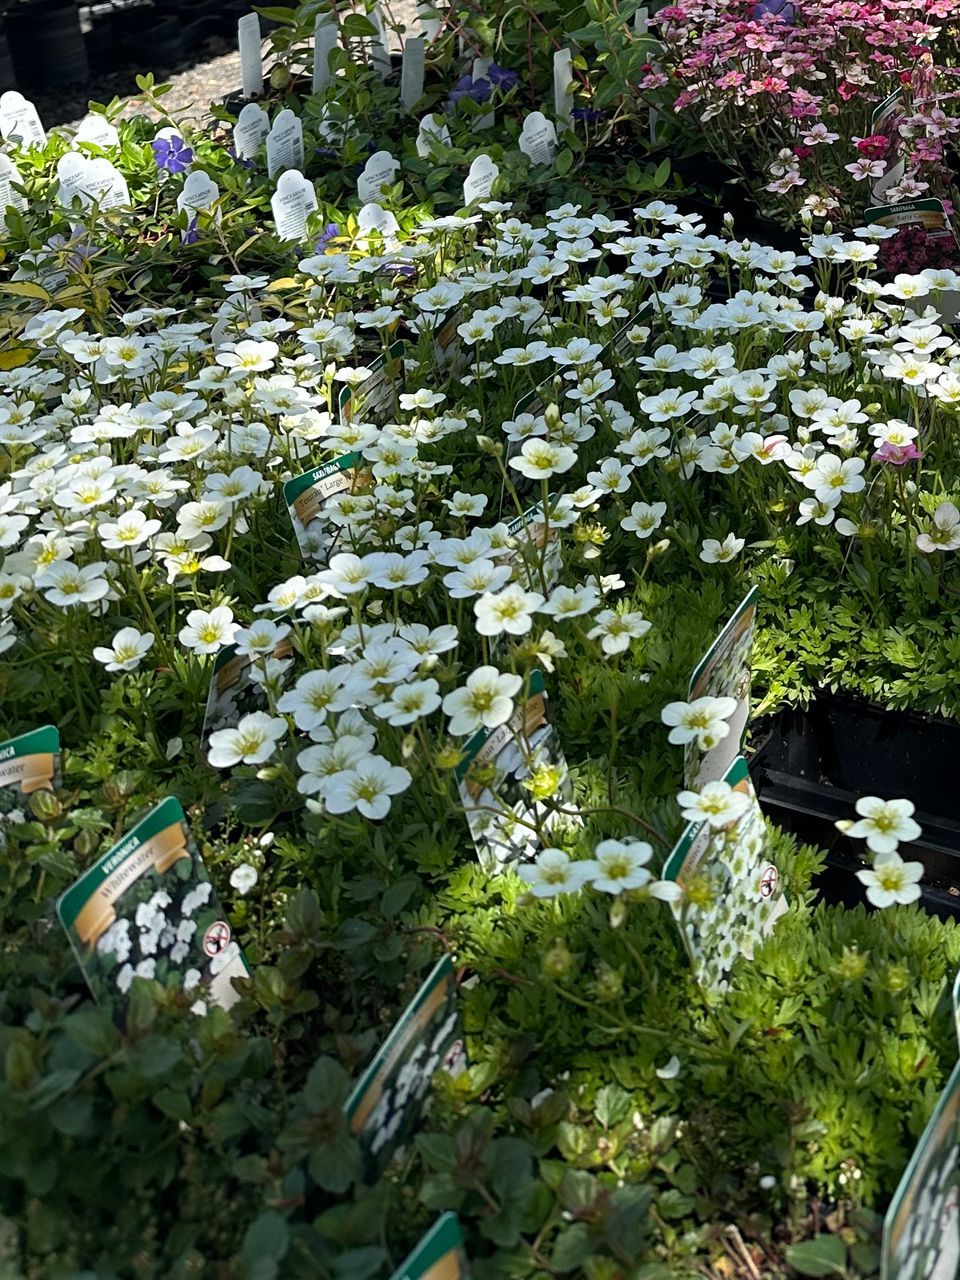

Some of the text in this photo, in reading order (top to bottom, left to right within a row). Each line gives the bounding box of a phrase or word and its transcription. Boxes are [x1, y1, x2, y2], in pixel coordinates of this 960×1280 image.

[324, 478, 344, 491] Large
[100, 846, 154, 898] Whitewater
[101, 836, 141, 874] VERONICA
